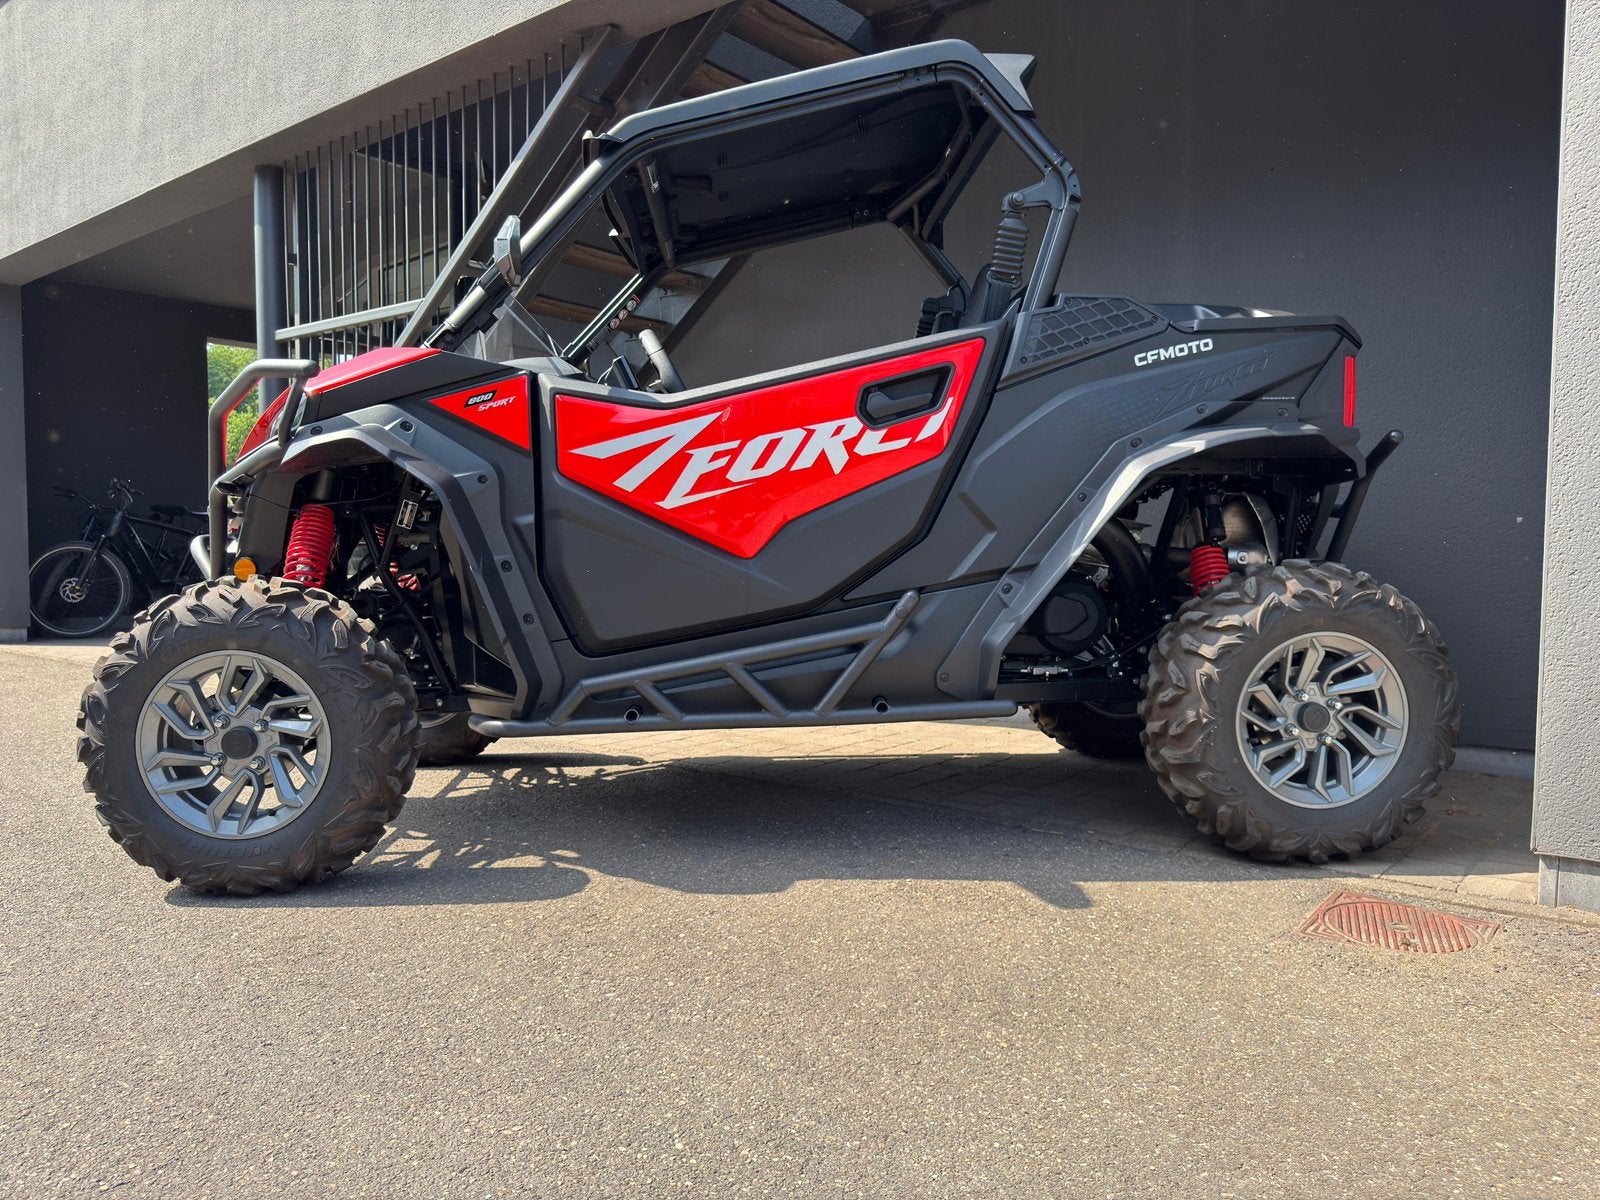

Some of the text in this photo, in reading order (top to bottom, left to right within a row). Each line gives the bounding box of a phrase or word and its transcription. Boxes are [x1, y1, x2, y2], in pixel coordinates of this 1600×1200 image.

[1134, 338, 1214, 367] CFMOTO
[467, 392, 494, 405] 800
[478, 396, 517, 412] SPORT
